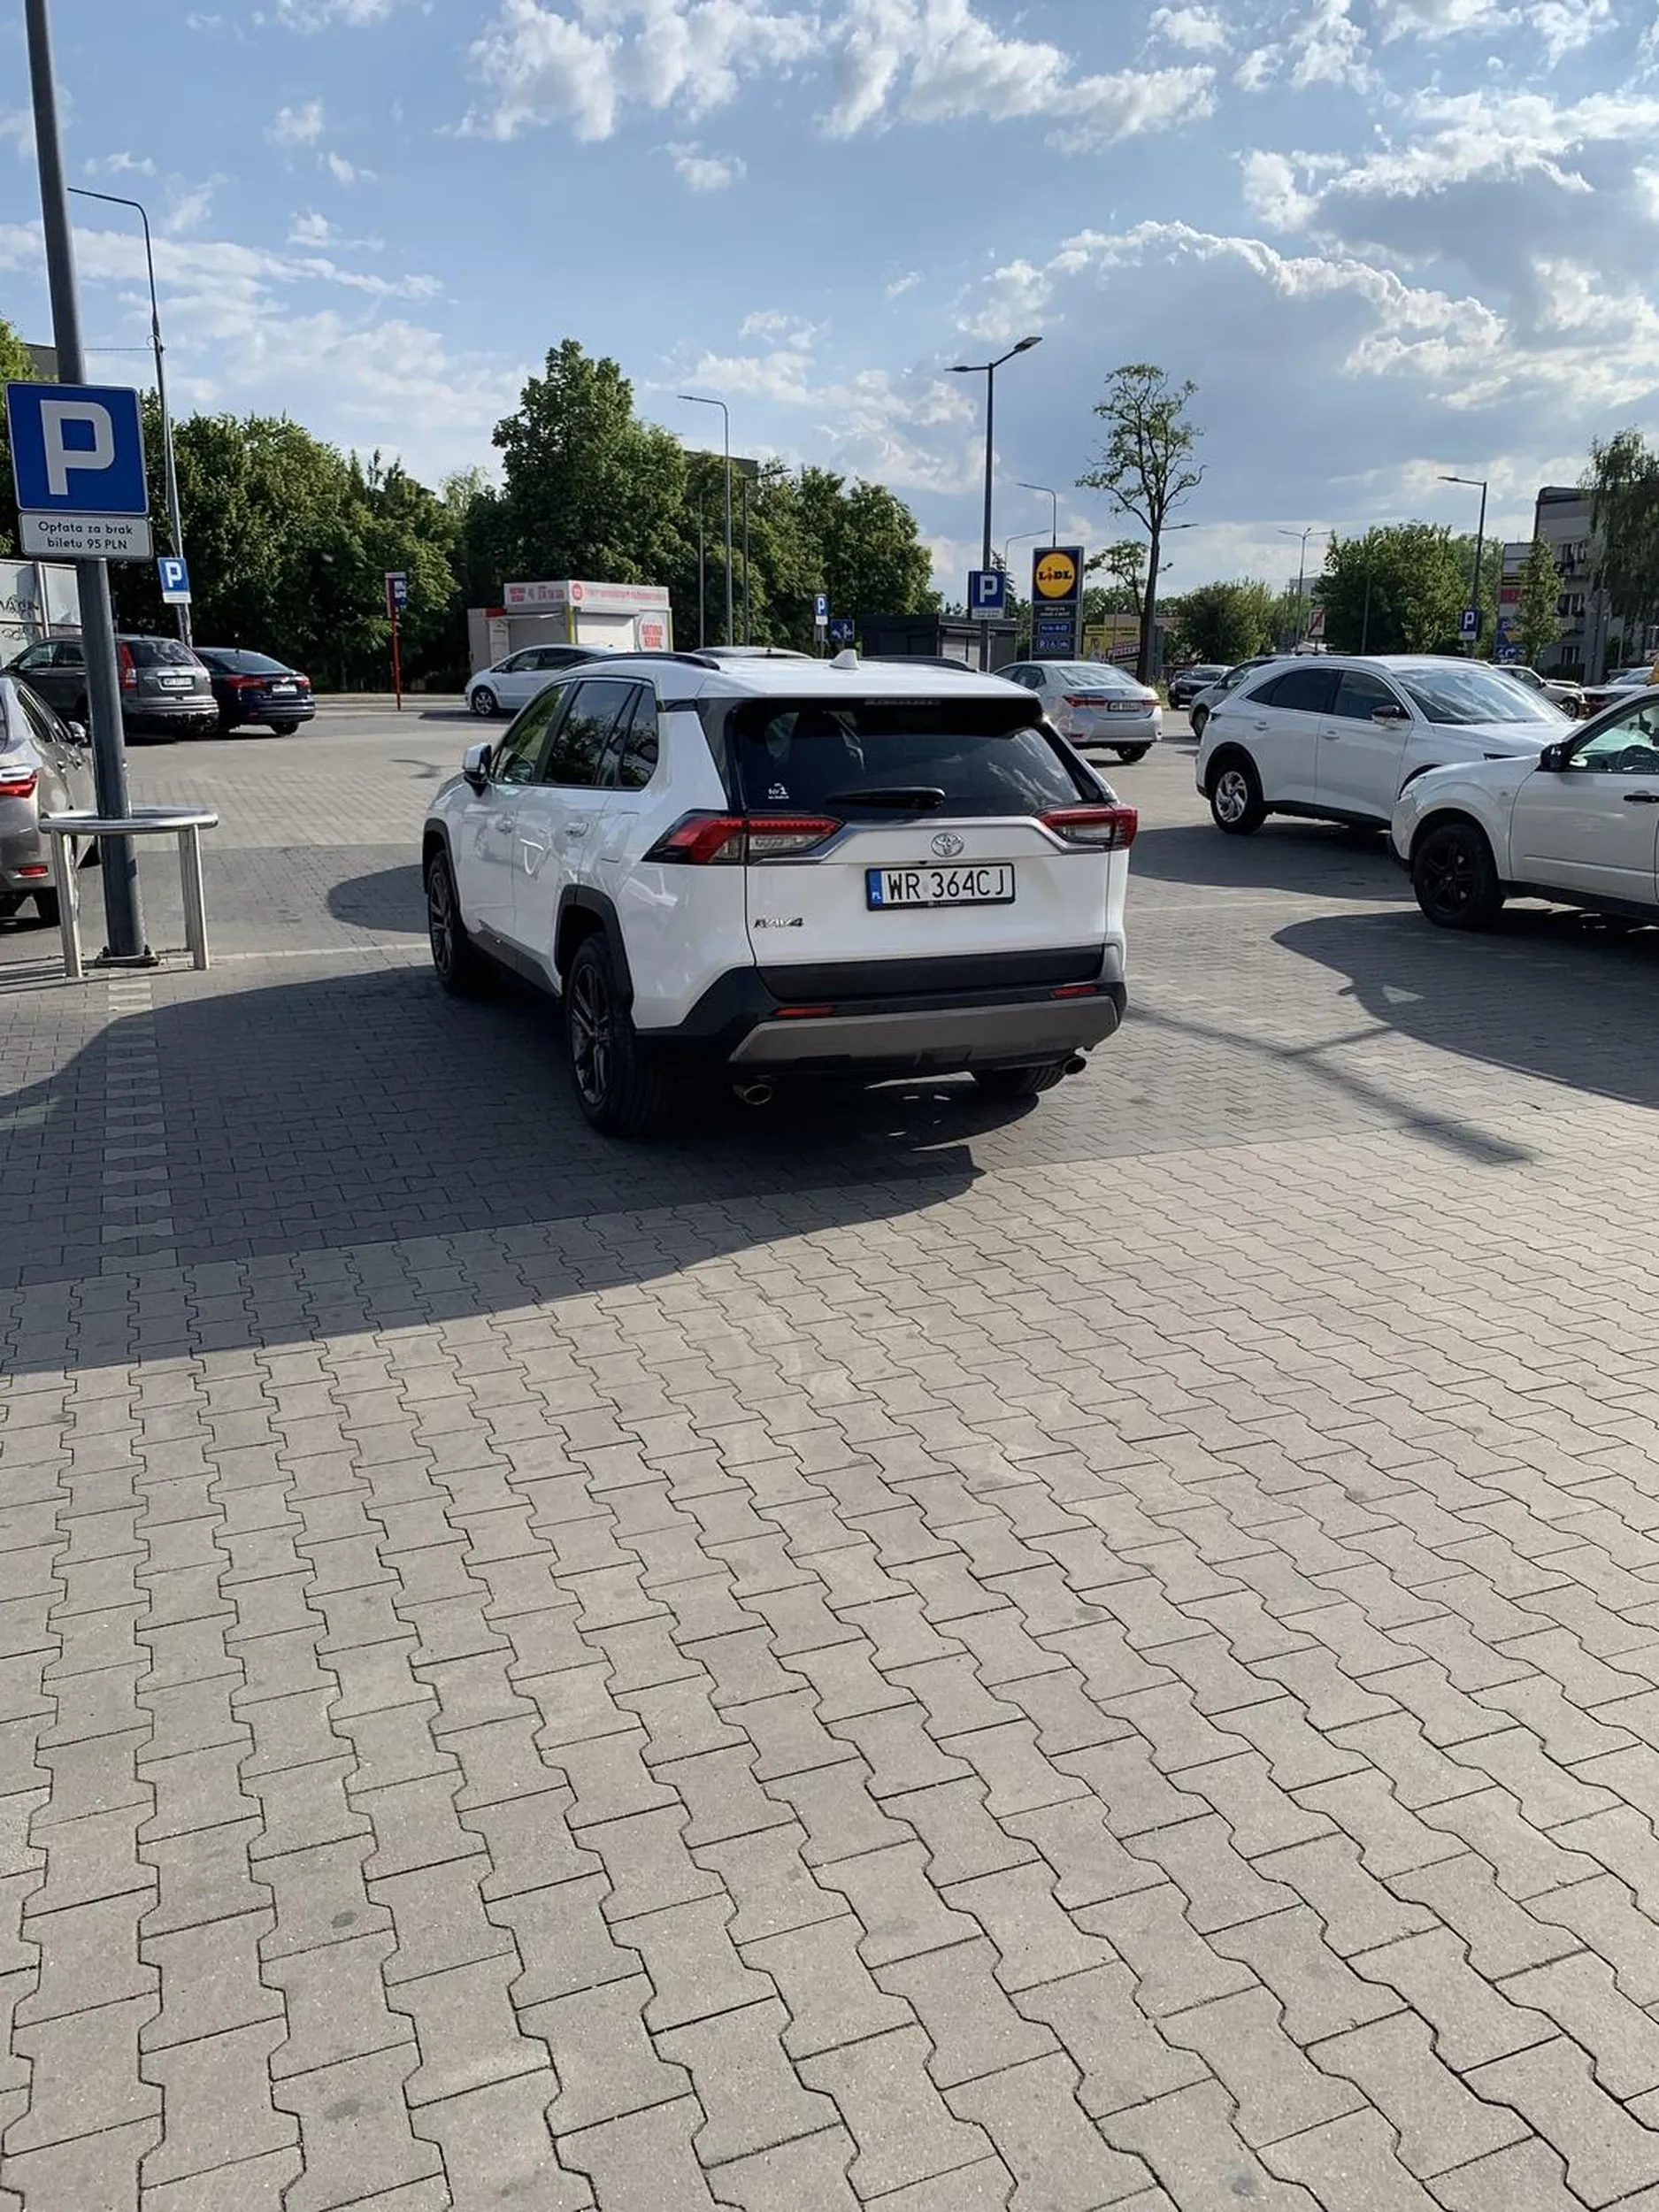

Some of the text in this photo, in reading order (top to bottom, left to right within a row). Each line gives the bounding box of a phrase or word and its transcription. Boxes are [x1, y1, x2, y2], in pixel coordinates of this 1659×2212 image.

[40, 400, 115, 495] P
[38, 521, 133, 535] Opłata za brak
[47, 537, 127, 550] biletu 95 PLN
[165, 562, 182, 588] P
[979, 575, 998, 603] P
[818, 597, 826, 614] P
[1463, 611, 1475, 630] P
[887, 869, 1003, 900] WR 364CJ
[753, 918, 803, 928] RAV4
